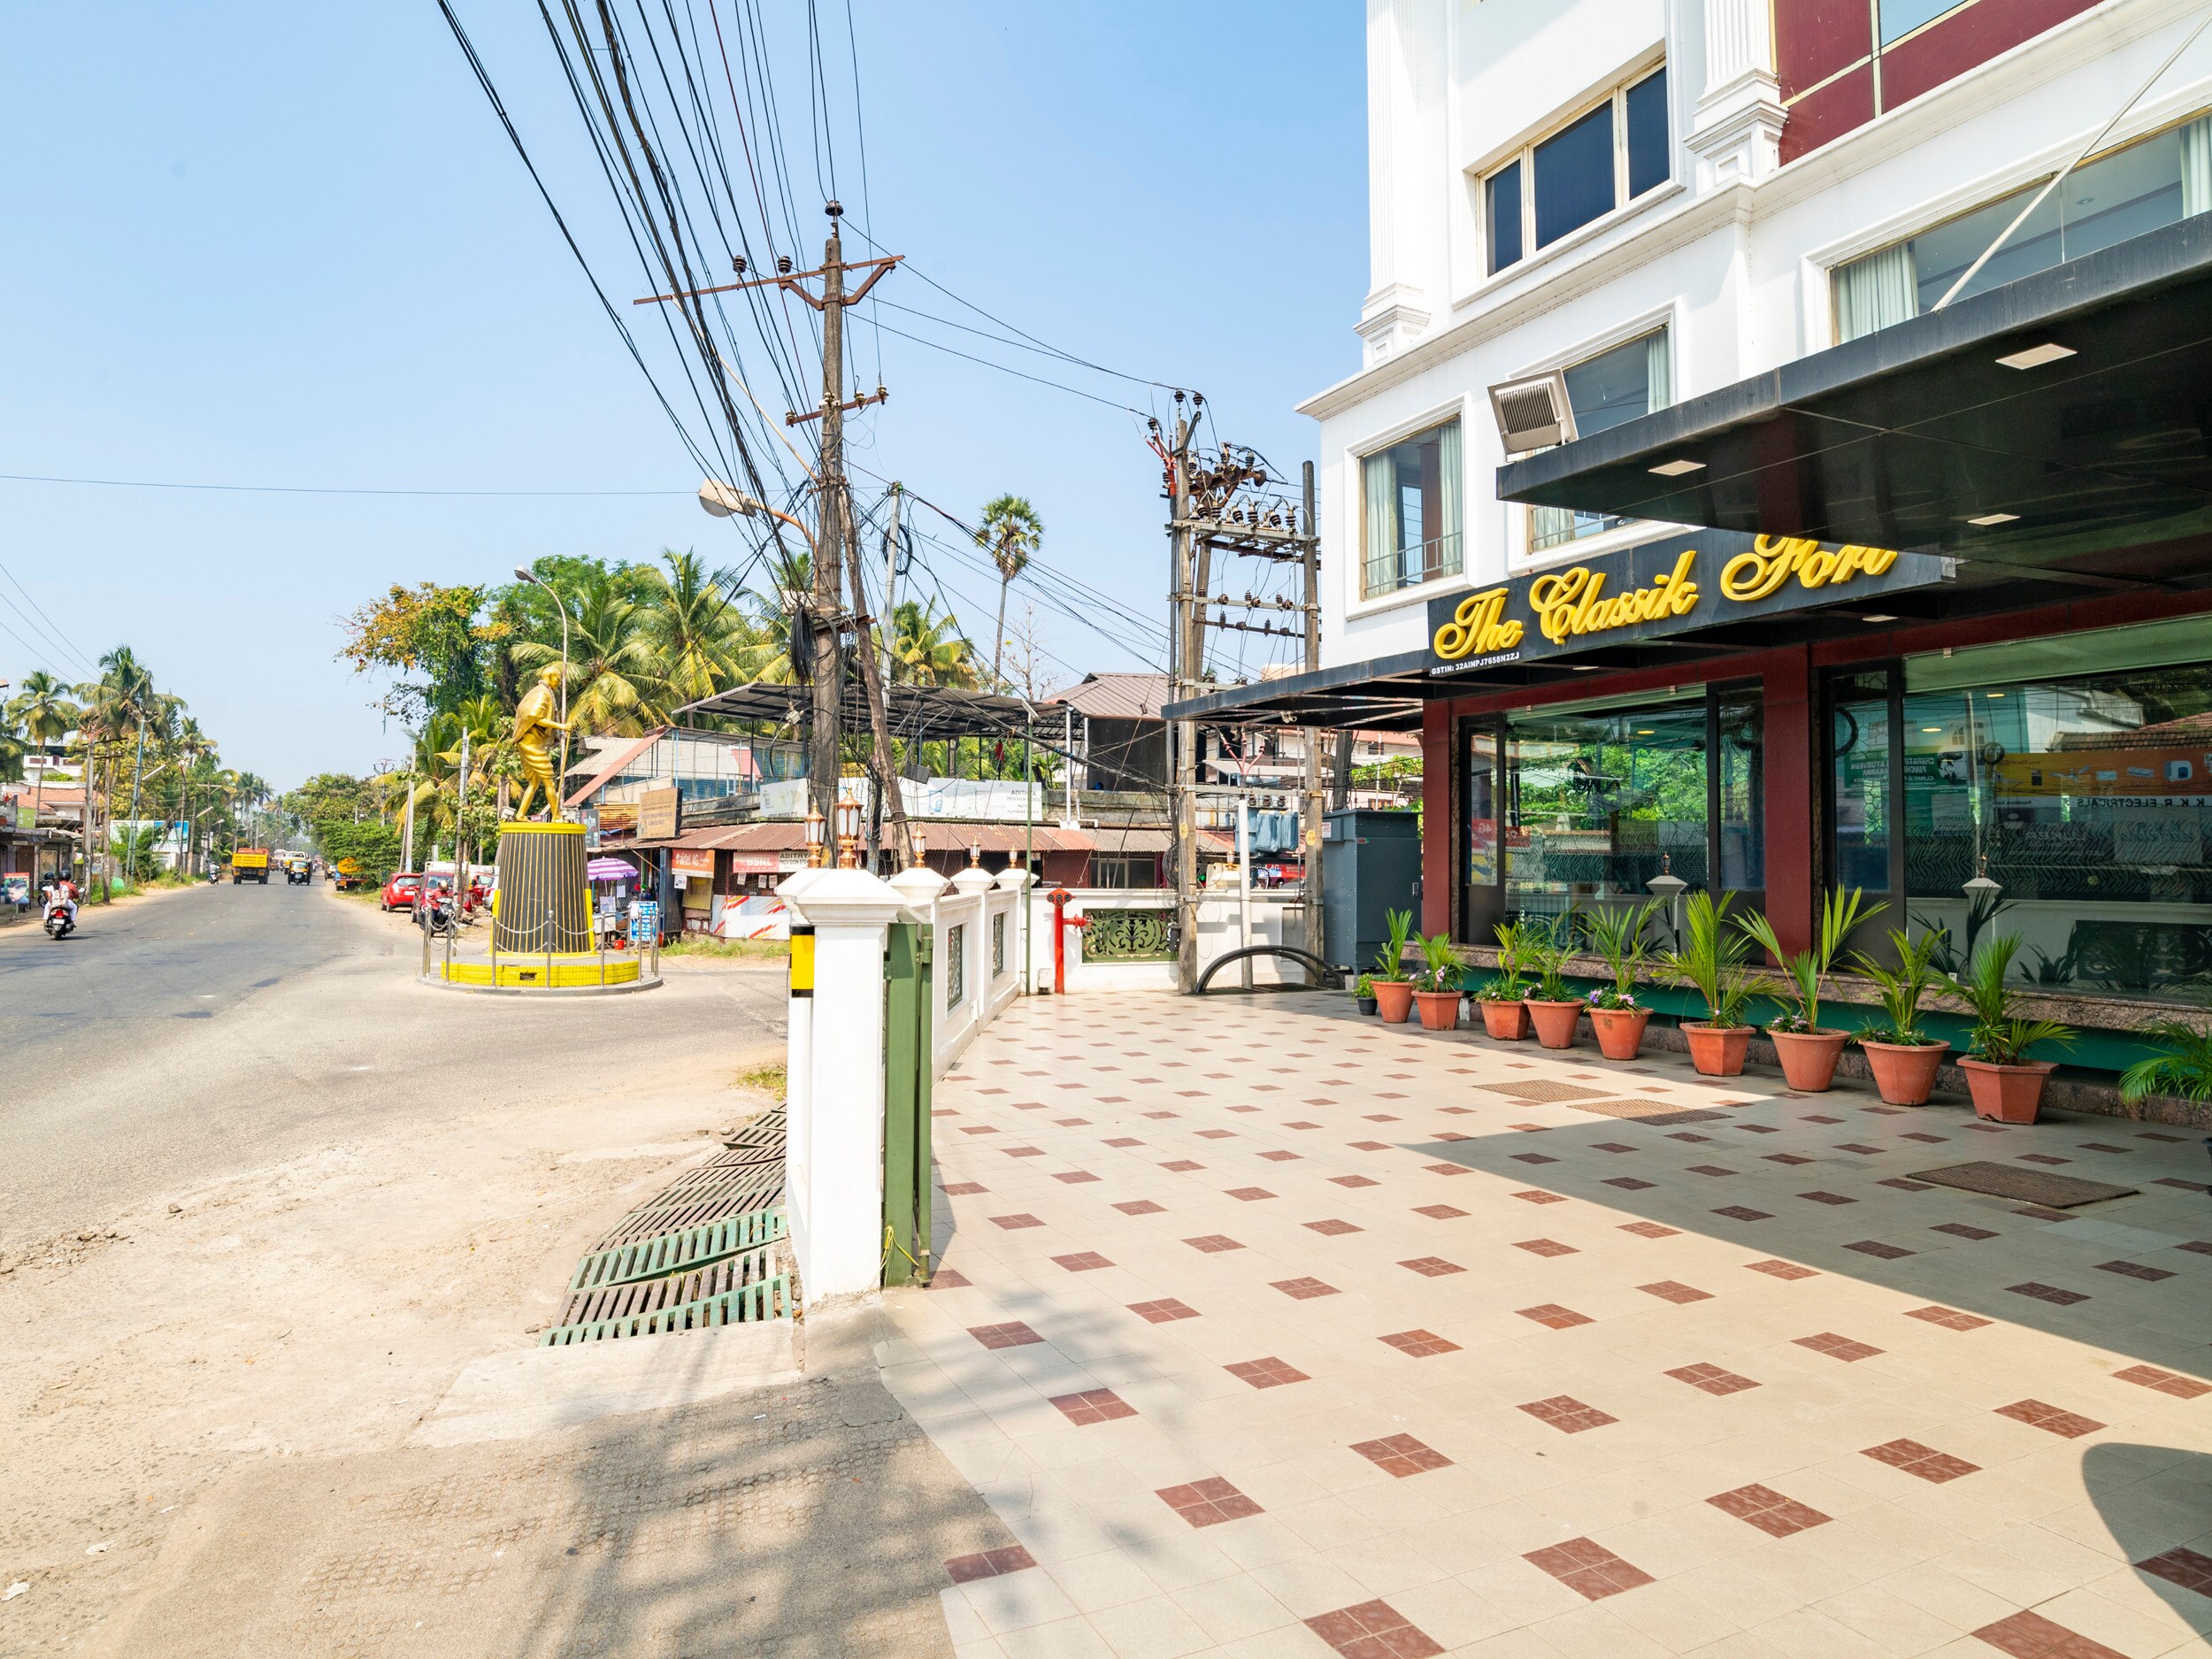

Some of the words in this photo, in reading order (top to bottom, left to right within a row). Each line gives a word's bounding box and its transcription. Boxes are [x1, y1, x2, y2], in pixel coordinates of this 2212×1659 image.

[1433, 588, 1524, 659] The
[1529, 550, 1699, 644] Classik
[1431, 665, 1455, 675] GSTIN:
[1455, 651, 1520, 671] 32AINPJ7658N2ZJ
